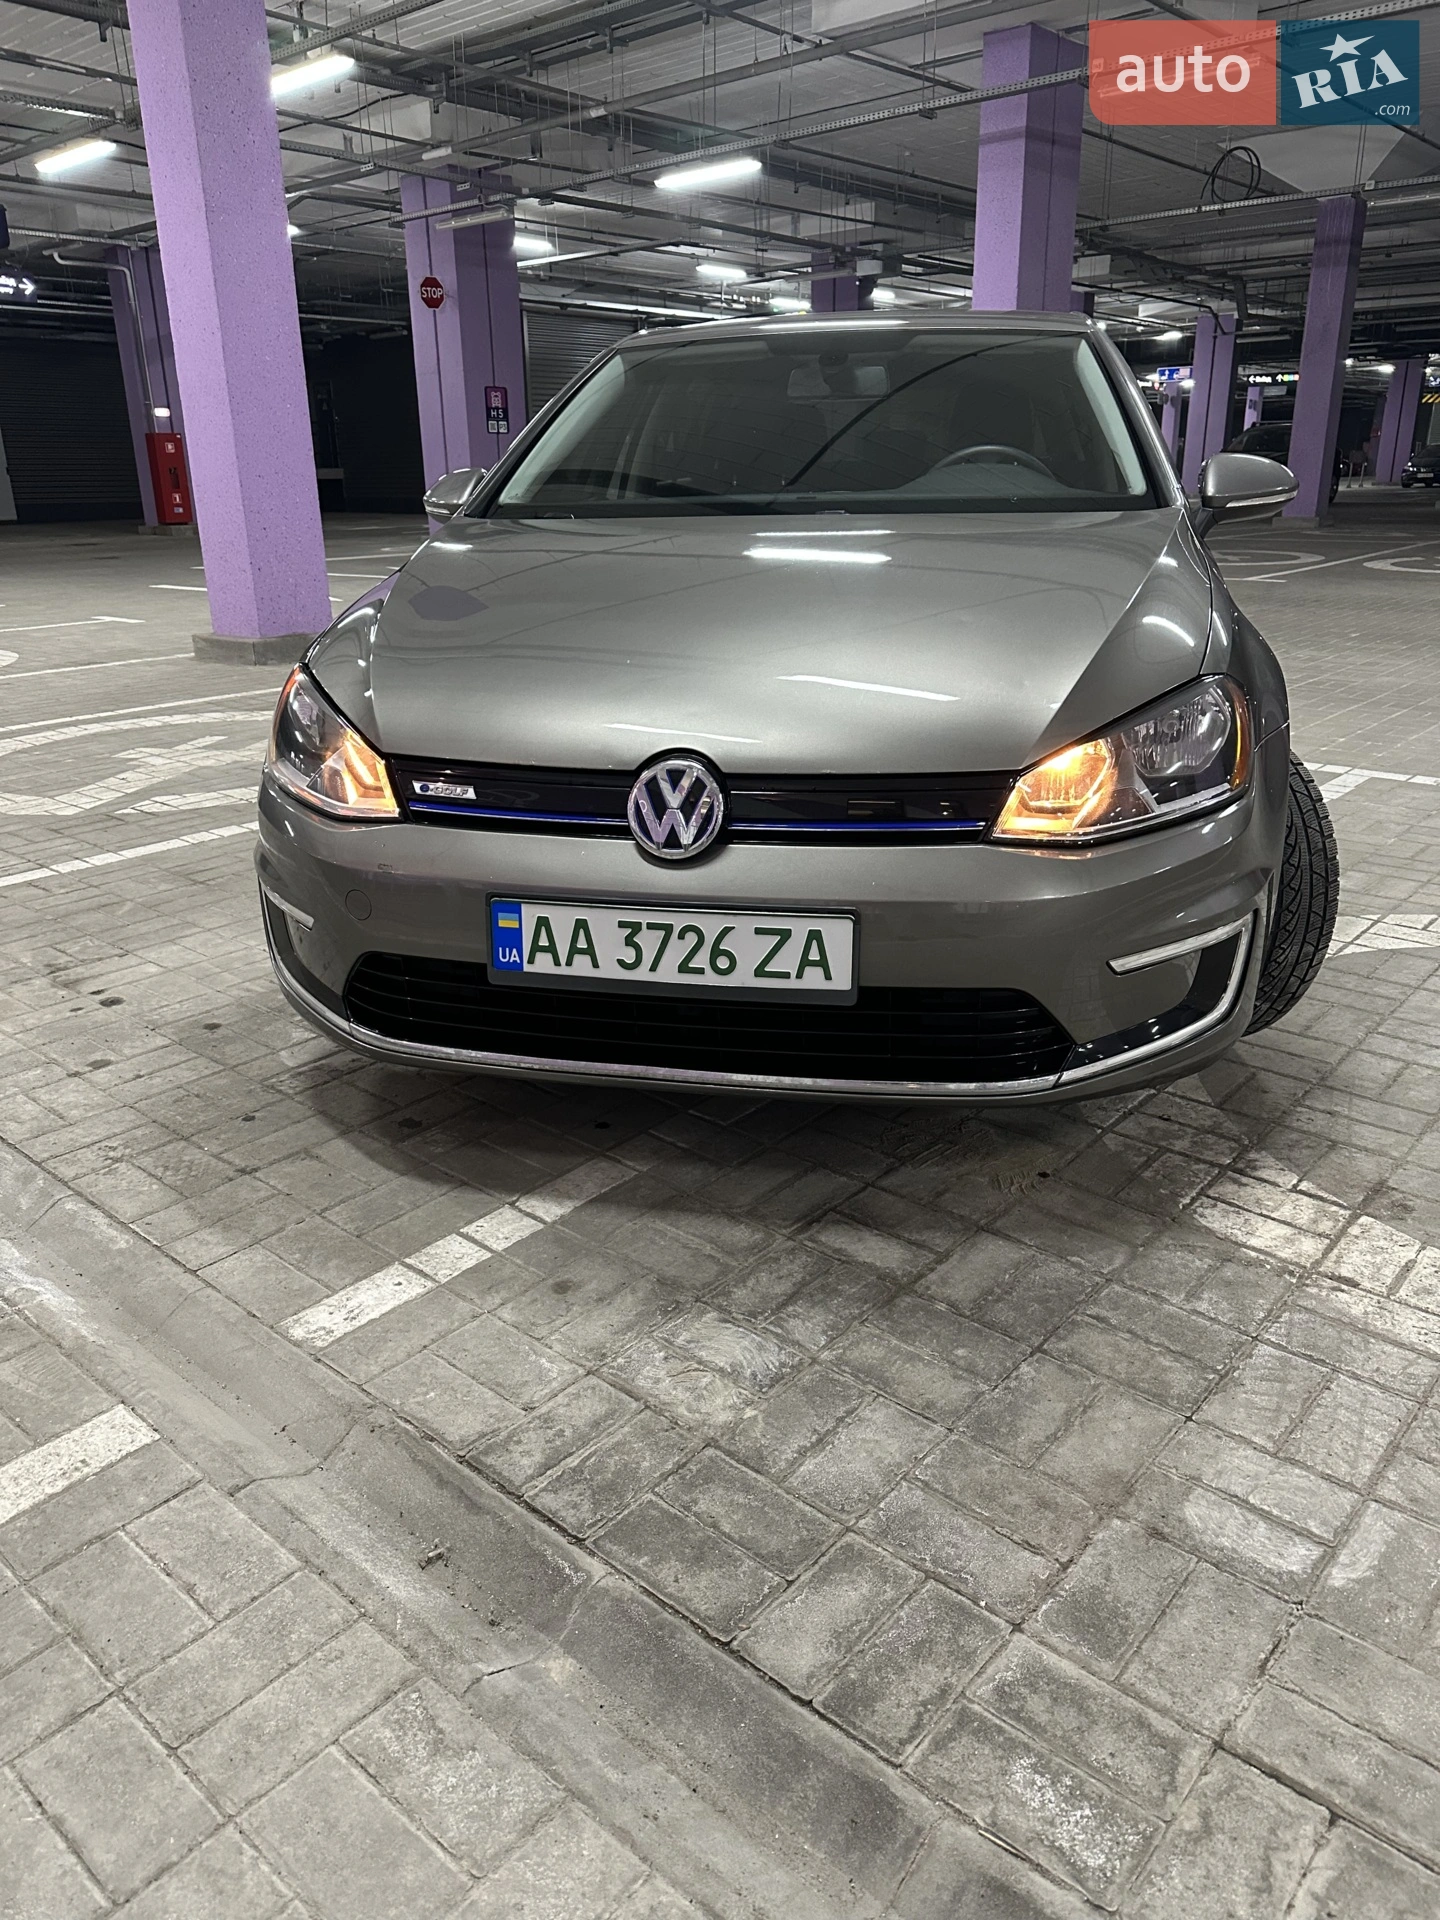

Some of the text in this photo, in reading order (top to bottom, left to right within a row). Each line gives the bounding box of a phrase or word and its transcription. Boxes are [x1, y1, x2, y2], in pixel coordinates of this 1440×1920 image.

[421, 286, 443, 299] STOP
[498, 946, 521, 964] UA
[526, 915, 833, 981] AA 3726 ZA
